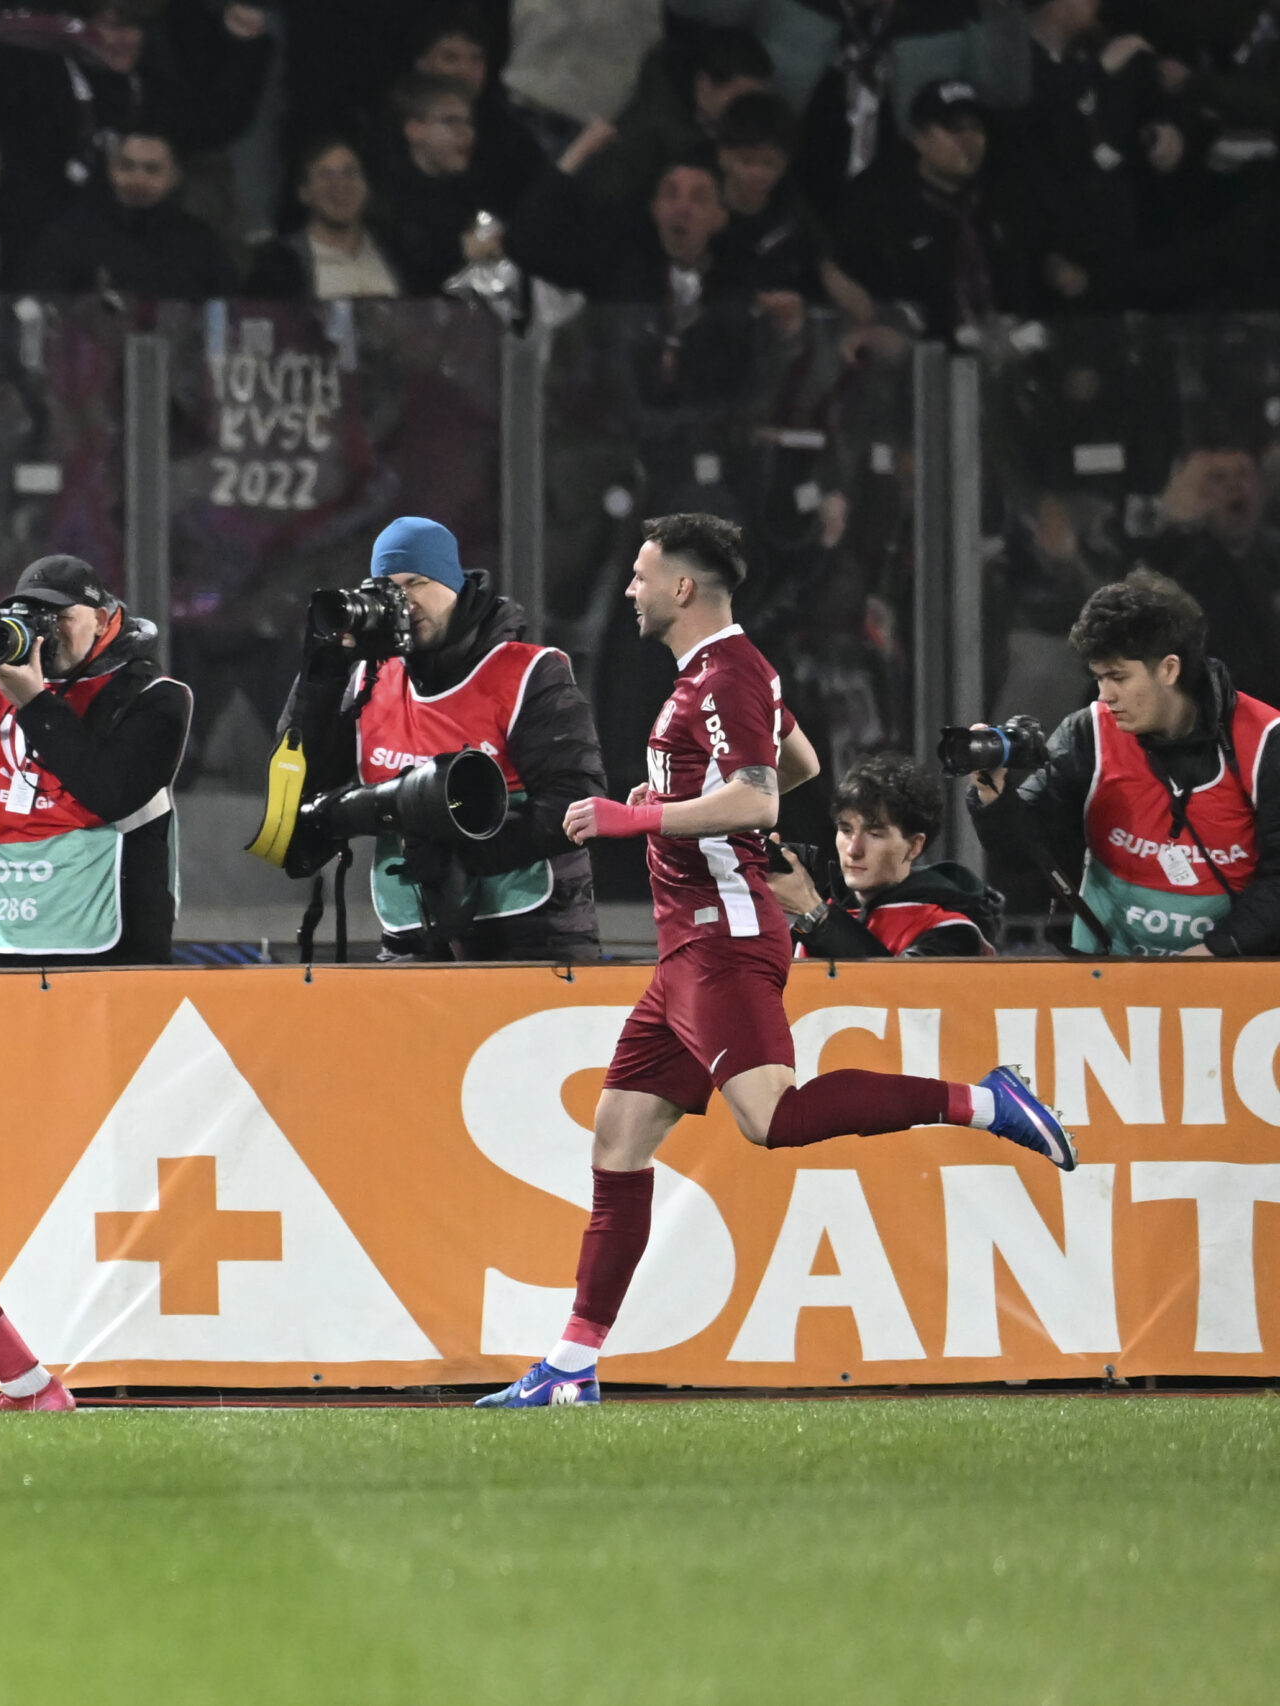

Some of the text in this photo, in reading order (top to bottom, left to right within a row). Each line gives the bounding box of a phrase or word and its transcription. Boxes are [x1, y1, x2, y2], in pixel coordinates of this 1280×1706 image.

[209, 456, 319, 510] 2022
[369, 740, 499, 771] SUPEA
[705, 713, 730, 759] DSC
[1108, 827, 1248, 865] SUPRLGA
